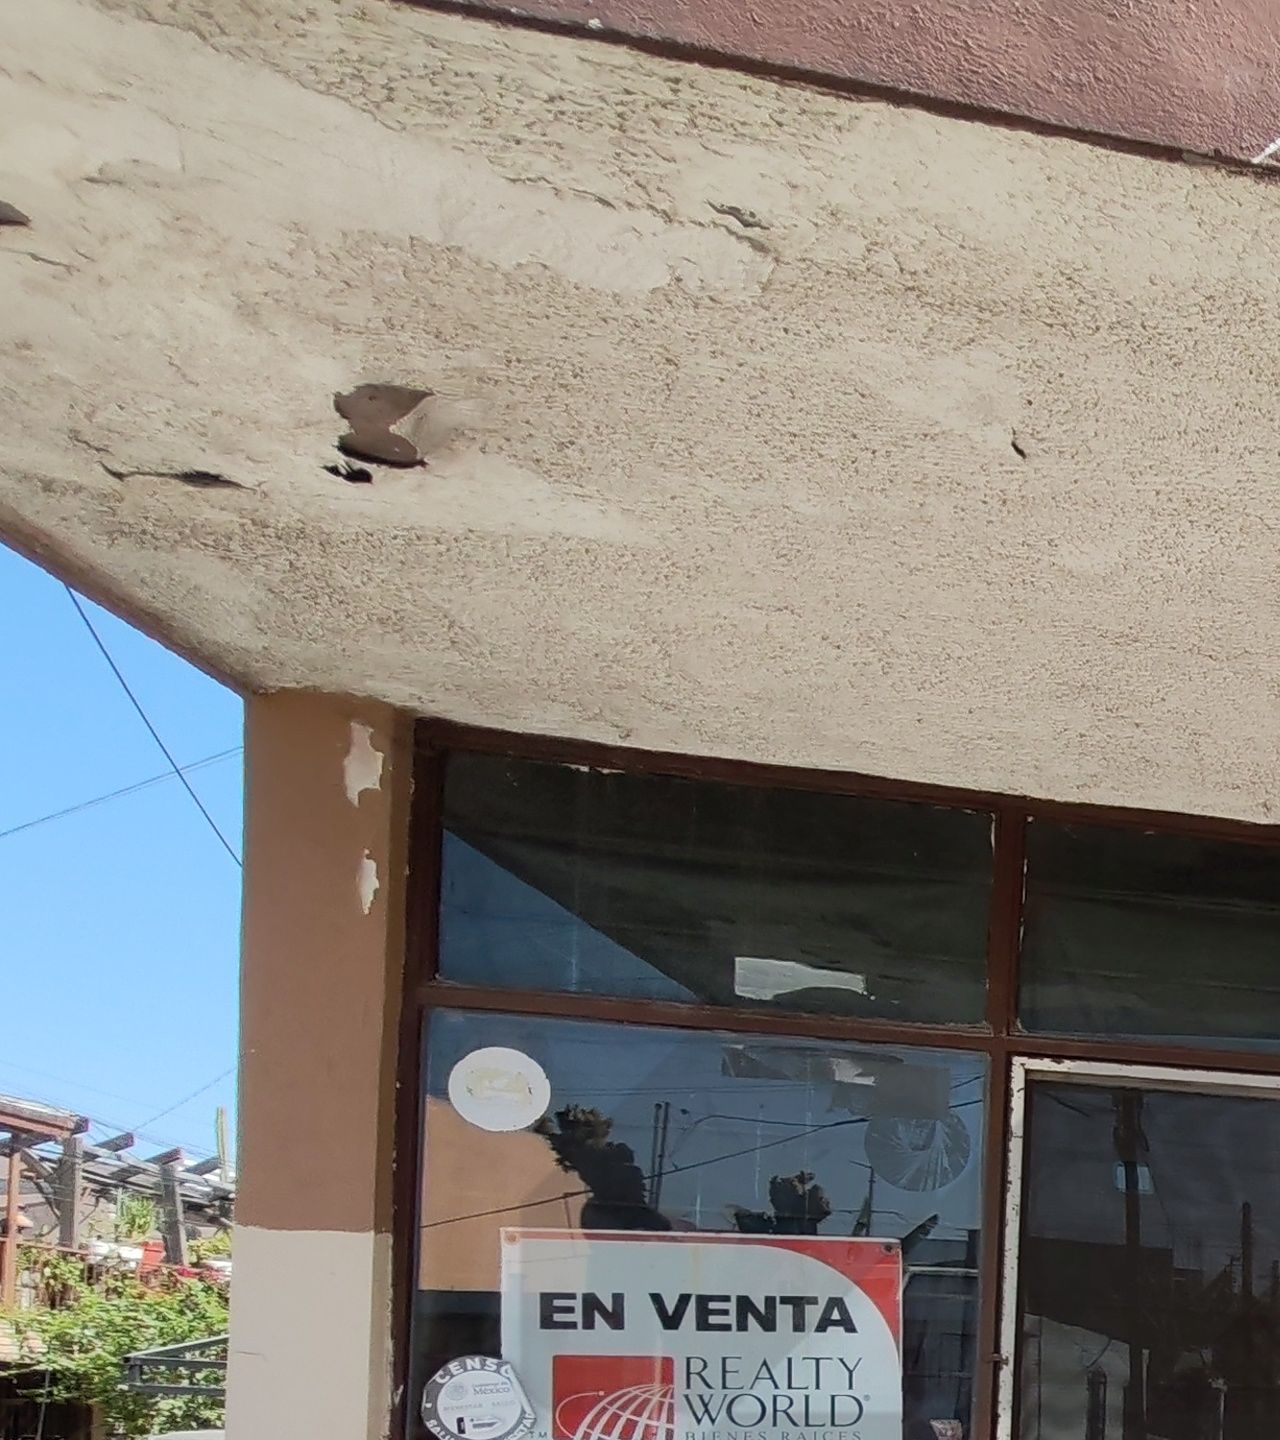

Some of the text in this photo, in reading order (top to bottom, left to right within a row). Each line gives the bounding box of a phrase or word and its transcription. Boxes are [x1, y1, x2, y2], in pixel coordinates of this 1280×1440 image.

[539, 1292, 858, 1333] EN VENTA
[684, 1356, 864, 1391] REALTY
